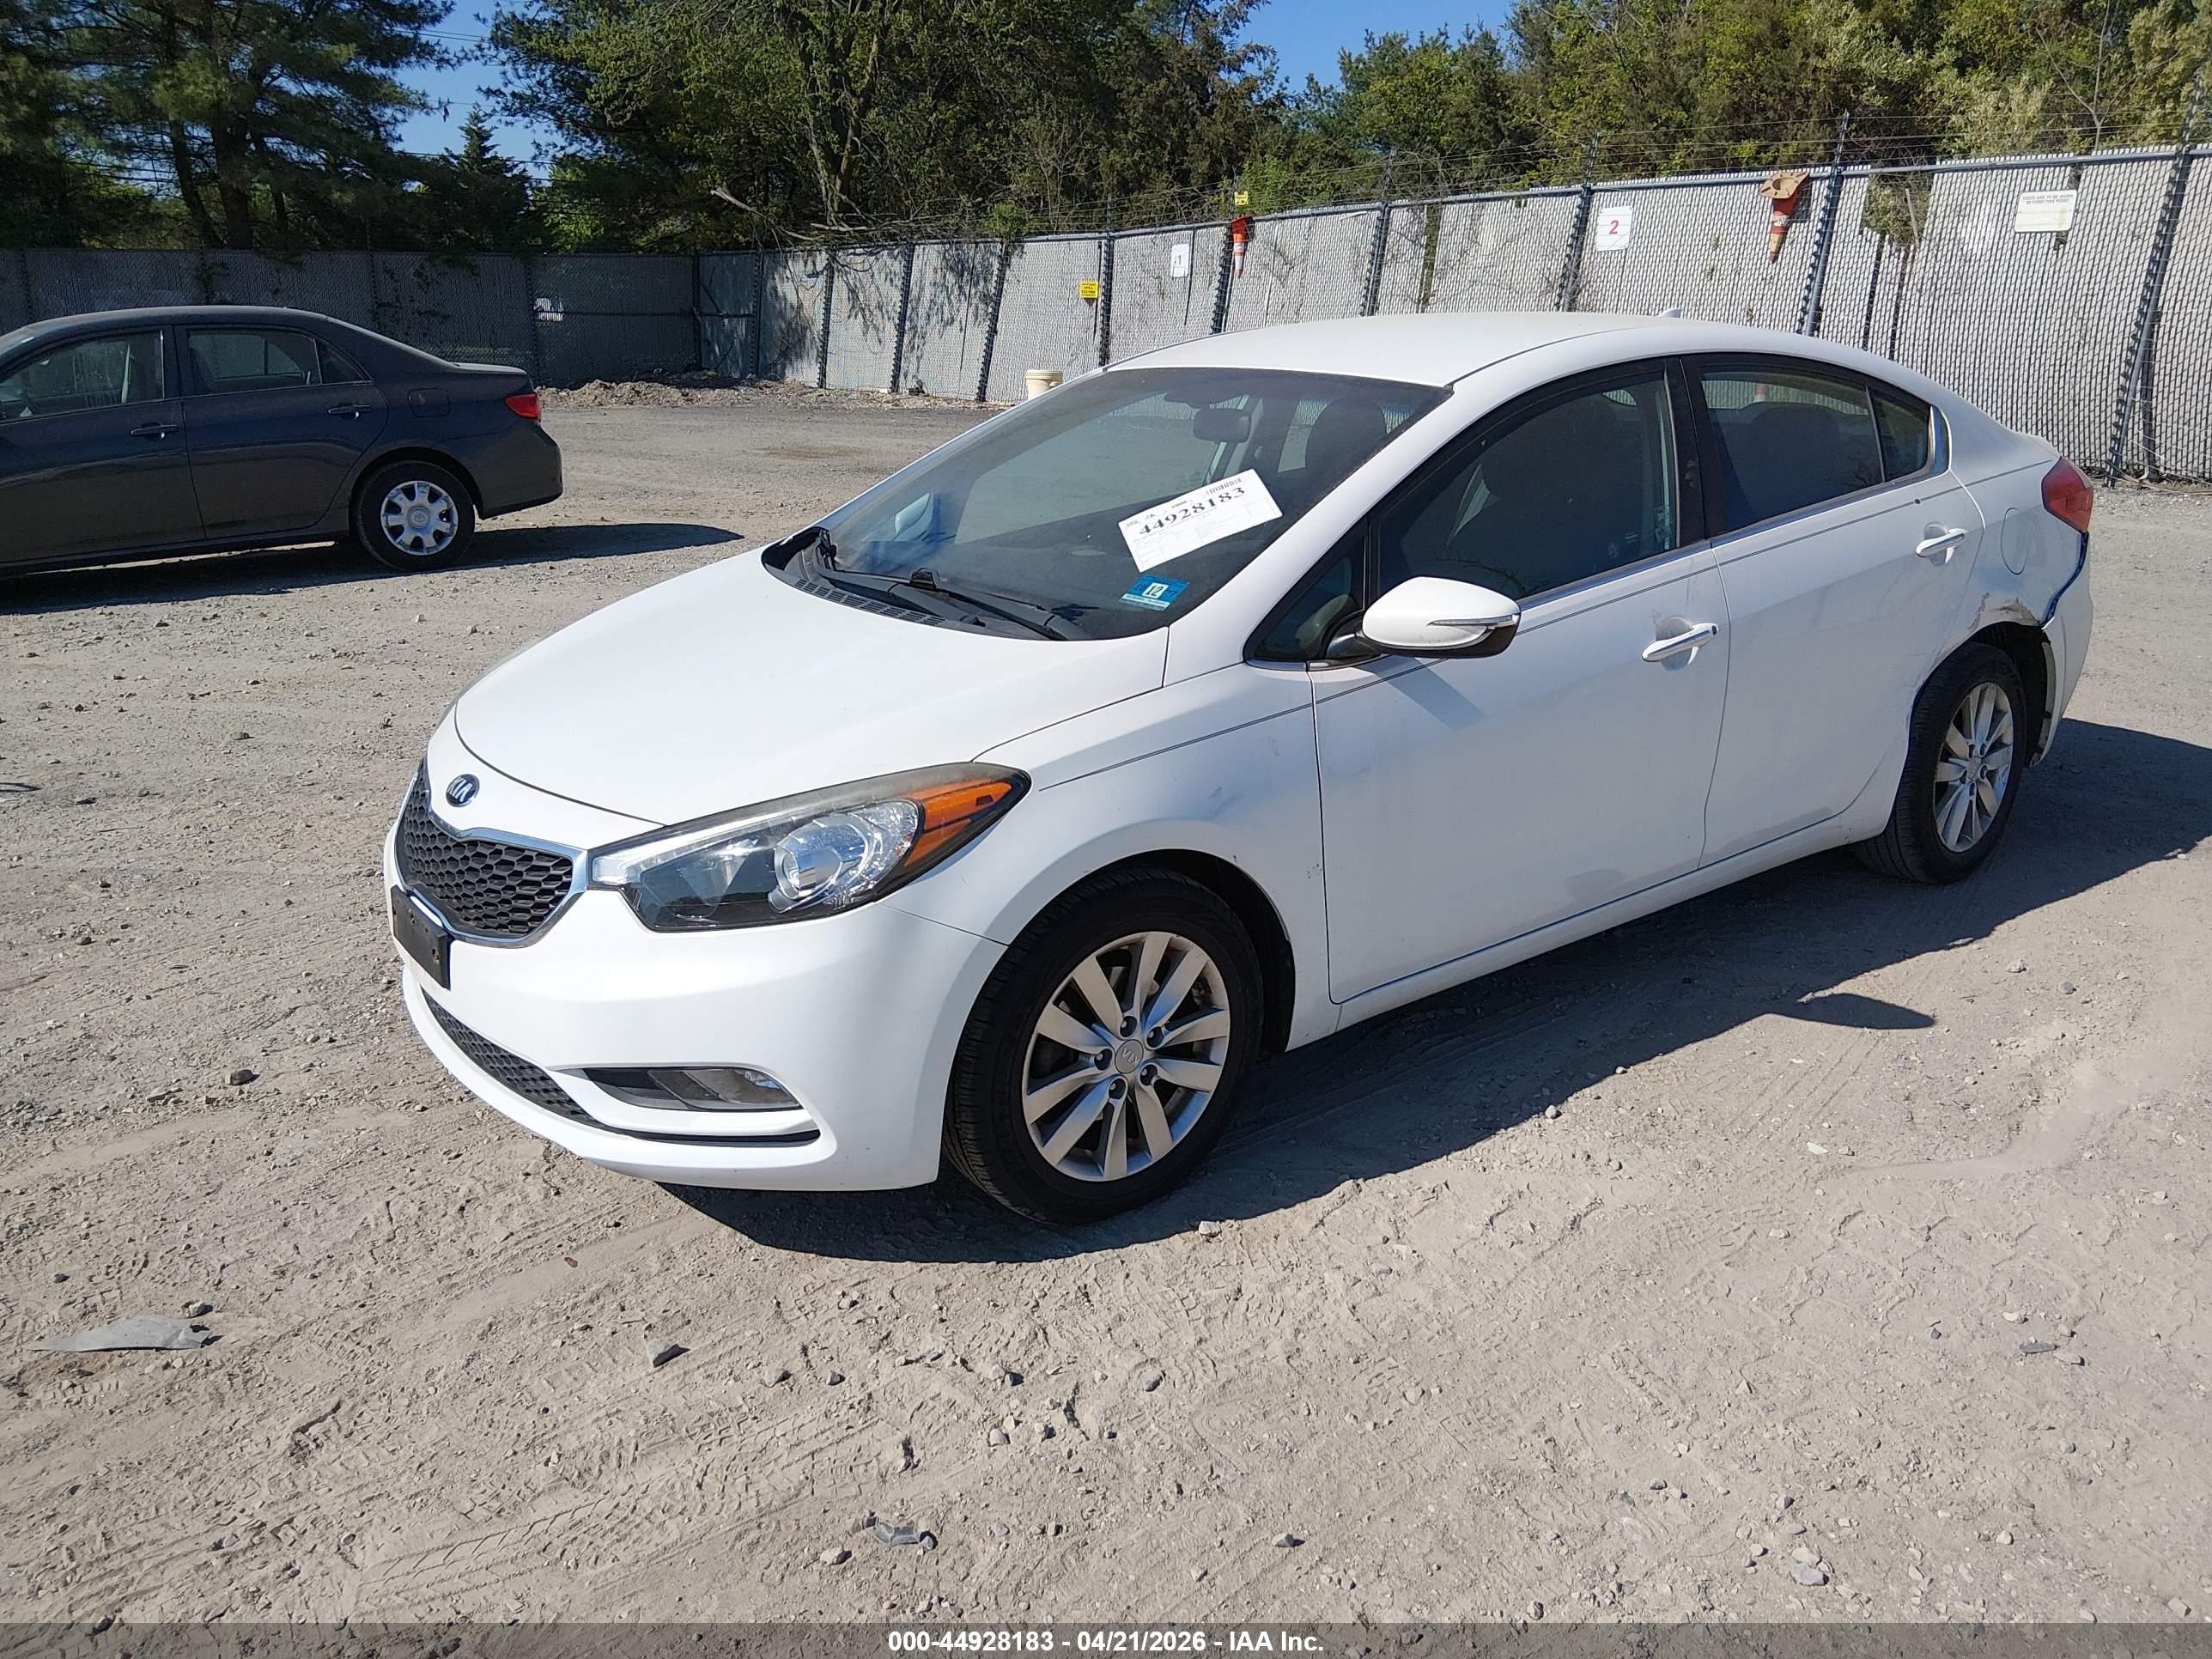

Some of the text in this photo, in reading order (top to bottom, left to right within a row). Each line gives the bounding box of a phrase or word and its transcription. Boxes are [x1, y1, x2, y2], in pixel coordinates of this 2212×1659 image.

[1608, 220, 1620, 235] 2
[1139, 487, 1246, 535] 44928183
[1145, 585, 1164, 597] 12
